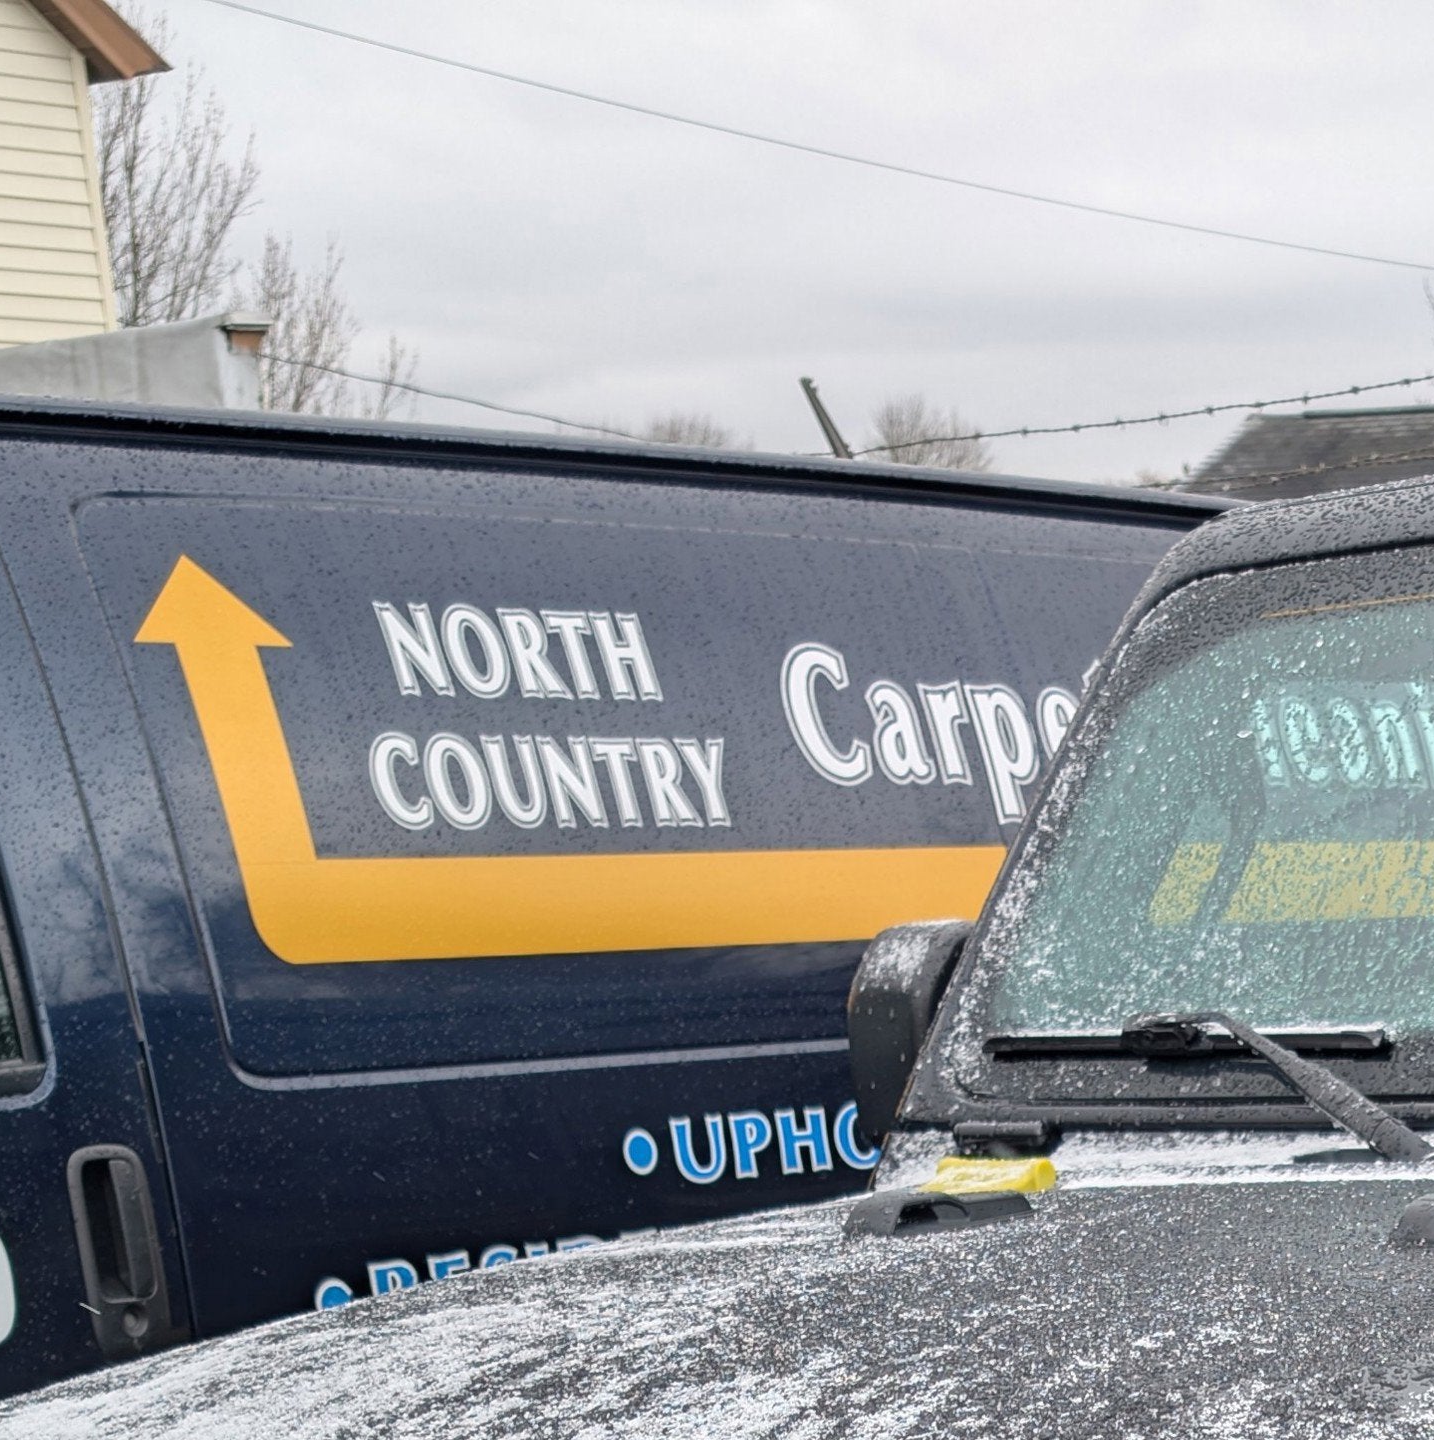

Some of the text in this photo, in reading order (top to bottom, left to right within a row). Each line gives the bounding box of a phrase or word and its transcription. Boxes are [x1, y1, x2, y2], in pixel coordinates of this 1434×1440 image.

[371, 601, 664, 703] NORTH
[368, 732, 731, 831] COUNTRY
[780, 640, 1102, 826] Carpe
